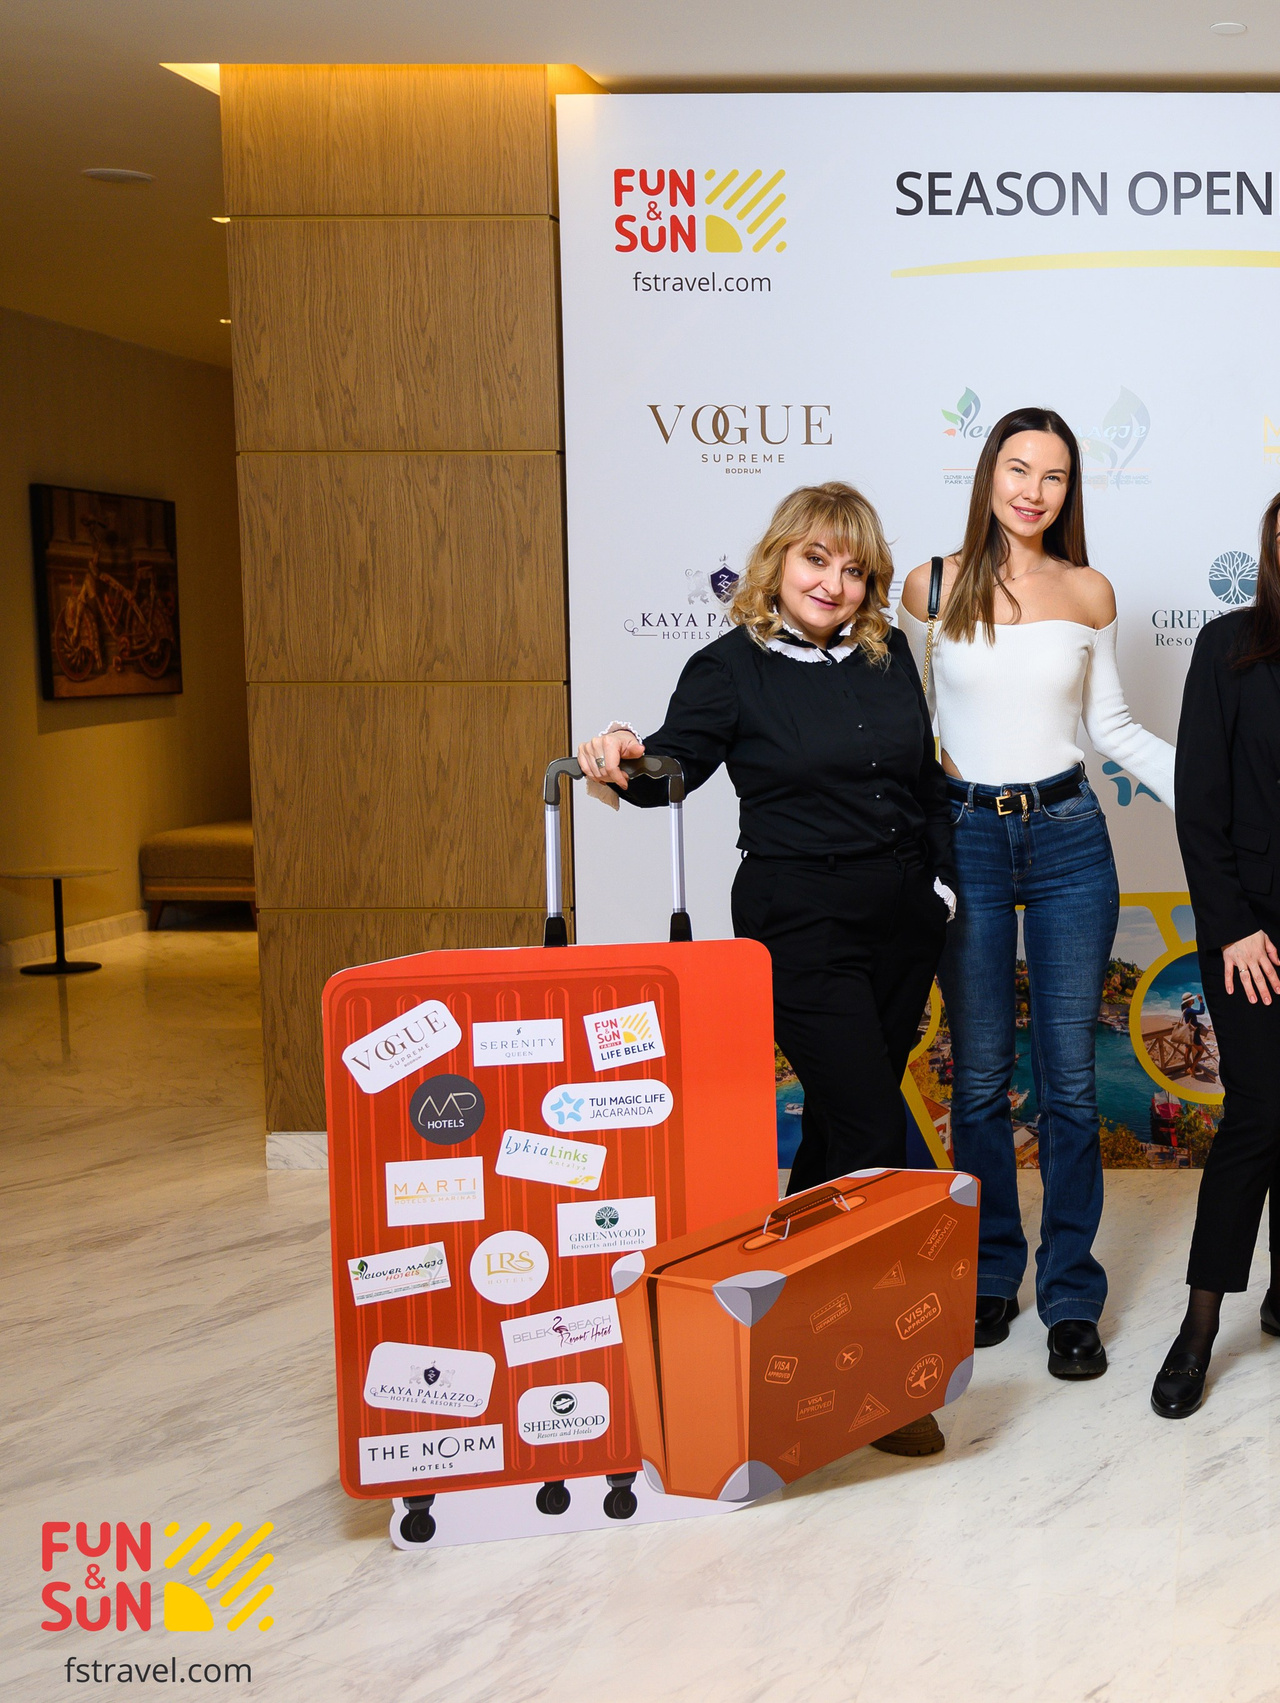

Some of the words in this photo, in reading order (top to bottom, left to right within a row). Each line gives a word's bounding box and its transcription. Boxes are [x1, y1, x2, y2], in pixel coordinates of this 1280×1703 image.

[614, 169, 695, 207] FUN
[895, 171, 1108, 216] SEASON
[647, 201, 662, 220] &
[615, 215, 696, 253] SUN
[633, 272, 771, 292] fstravel.com
[647, 404, 833, 445] VOGUE
[701, 453, 785, 463] SUPREME
[641, 612, 699, 627] KAYA
[662, 631, 711, 640] HOTELS
[1155, 633, 1197, 646] Reso
[594, 1018, 618, 1032] FUN
[351, 1010, 447, 1071] VOGUE
[480, 1038, 556, 1050] SERENITY
[597, 1030, 621, 1044] SUN
[389, 1043, 430, 1069] SUPREME
[601, 1049, 622, 1061] LIFE
[624, 1041, 655, 1055] BELEK
[589, 1097, 607, 1107] TUI
[609, 1095, 642, 1106] MAGIC
[644, 1093, 666, 1104] LIFE
[590, 1106, 653, 1119] JACARANDA
[427, 1118, 464, 1129] HOTELS
[394, 1178, 476, 1195] MARTI
[569, 1228, 646, 1242] GREENWOOD
[927, 1228, 941, 1245] VISA
[927, 1220, 953, 1256] APPROVED
[485, 1250, 535, 1276] LRS
[487, 1277, 534, 1285] HOTELS
[815, 1307, 848, 1331] DEPARTURE
[904, 1303, 931, 1324] VISA
[904, 1307, 937, 1335] APPROVED
[512, 1326, 552, 1343] BELEK
[568, 1315, 611, 1331] BEACH
[774, 1360, 790, 1371] VISA
[908, 1356, 938, 1382] ARRIVAL
[768, 1371, 790, 1379] APPROVED
[379, 1385, 413, 1396] KAYA
[417, 1389, 475, 1402] PALAZZO
[807, 1396, 823, 1405] VISA
[430, 1400, 461, 1408] RESORTS
[799, 1400, 832, 1414] APPROVED
[523, 1415, 605, 1433] SHERWOOD
[573, 1427, 592, 1435] Hotels
[368, 1444, 410, 1461] THE
[422, 1436, 496, 1458] NORM
[412, 1462, 454, 1472] HOTELS
